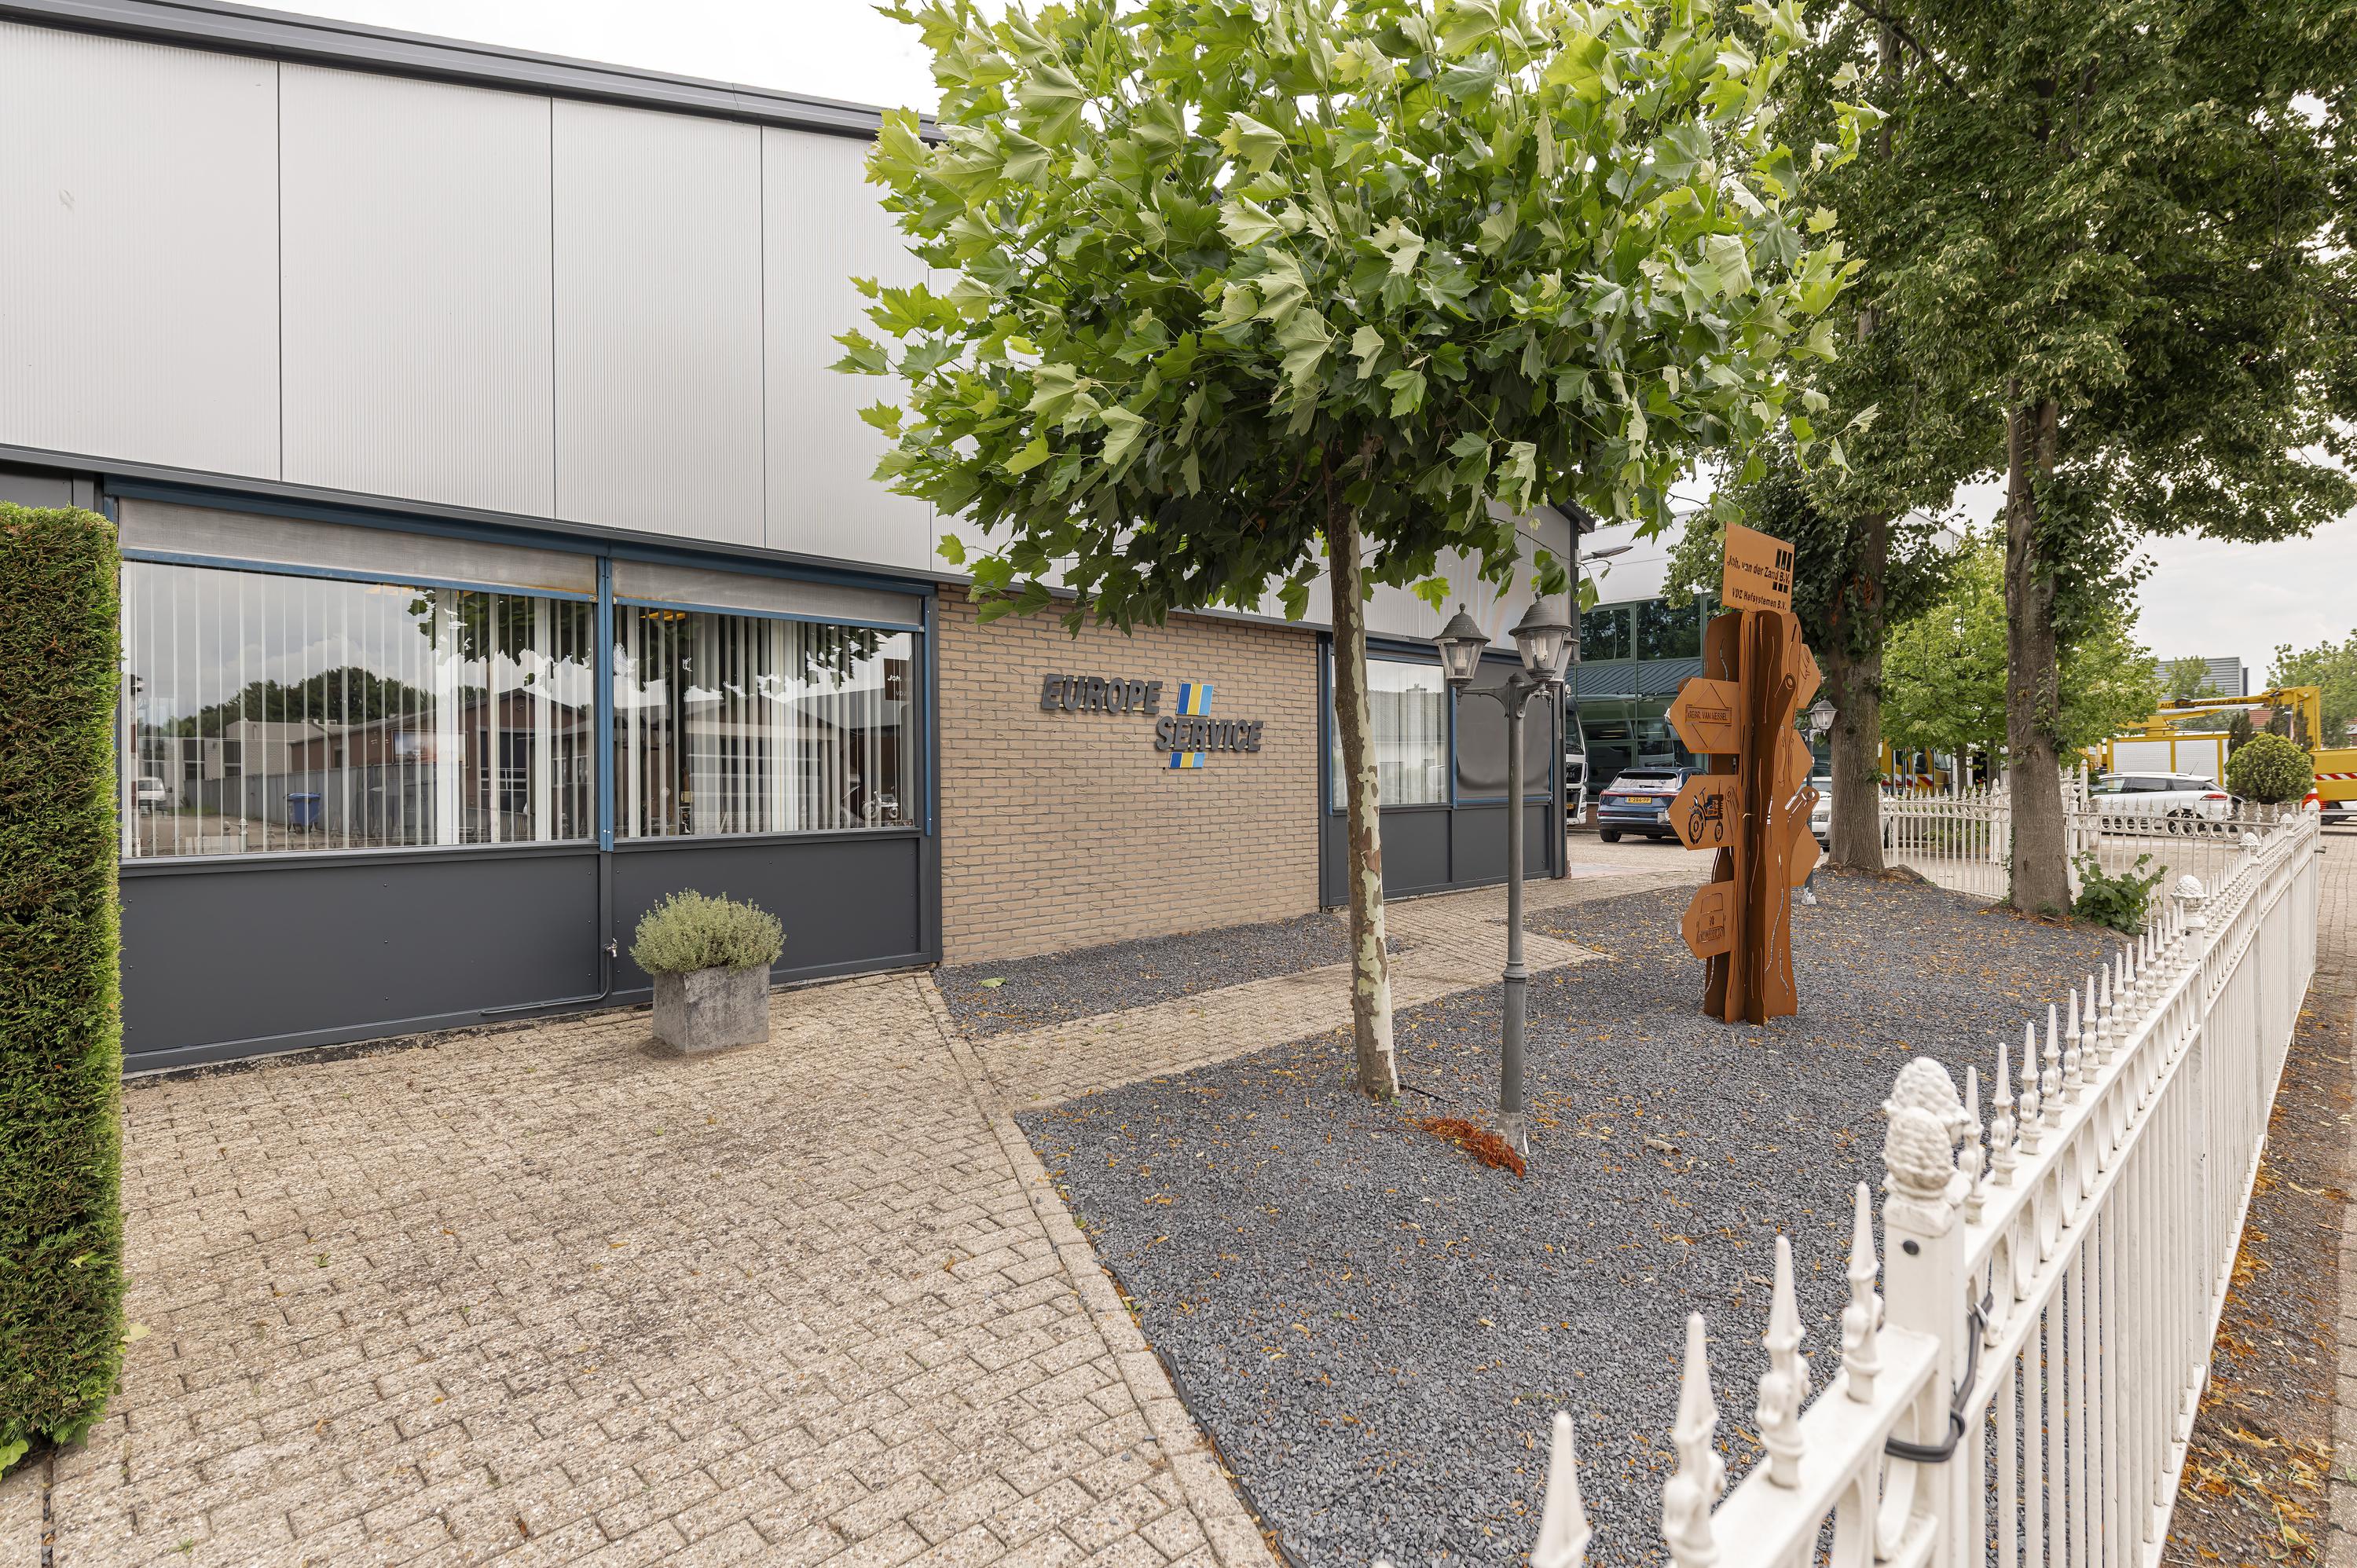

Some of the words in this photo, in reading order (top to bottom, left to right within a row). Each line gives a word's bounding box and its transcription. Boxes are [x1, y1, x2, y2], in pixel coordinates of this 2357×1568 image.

[1727, 555, 1740, 570] Joh.
[1742, 561, 1753, 573] van
[1753, 563, 1764, 576] der
[1764, 566, 1780, 581] Zand
[1780, 571, 1791, 584] B.V.
[1732, 587, 1743, 599] VDZ
[1743, 590, 1776, 608] Hefsystemen
[1777, 599, 1787, 610] B.V.
[1042, 673, 1163, 714] EUROPE
[1156, 716, 1263, 751] SERVICE
